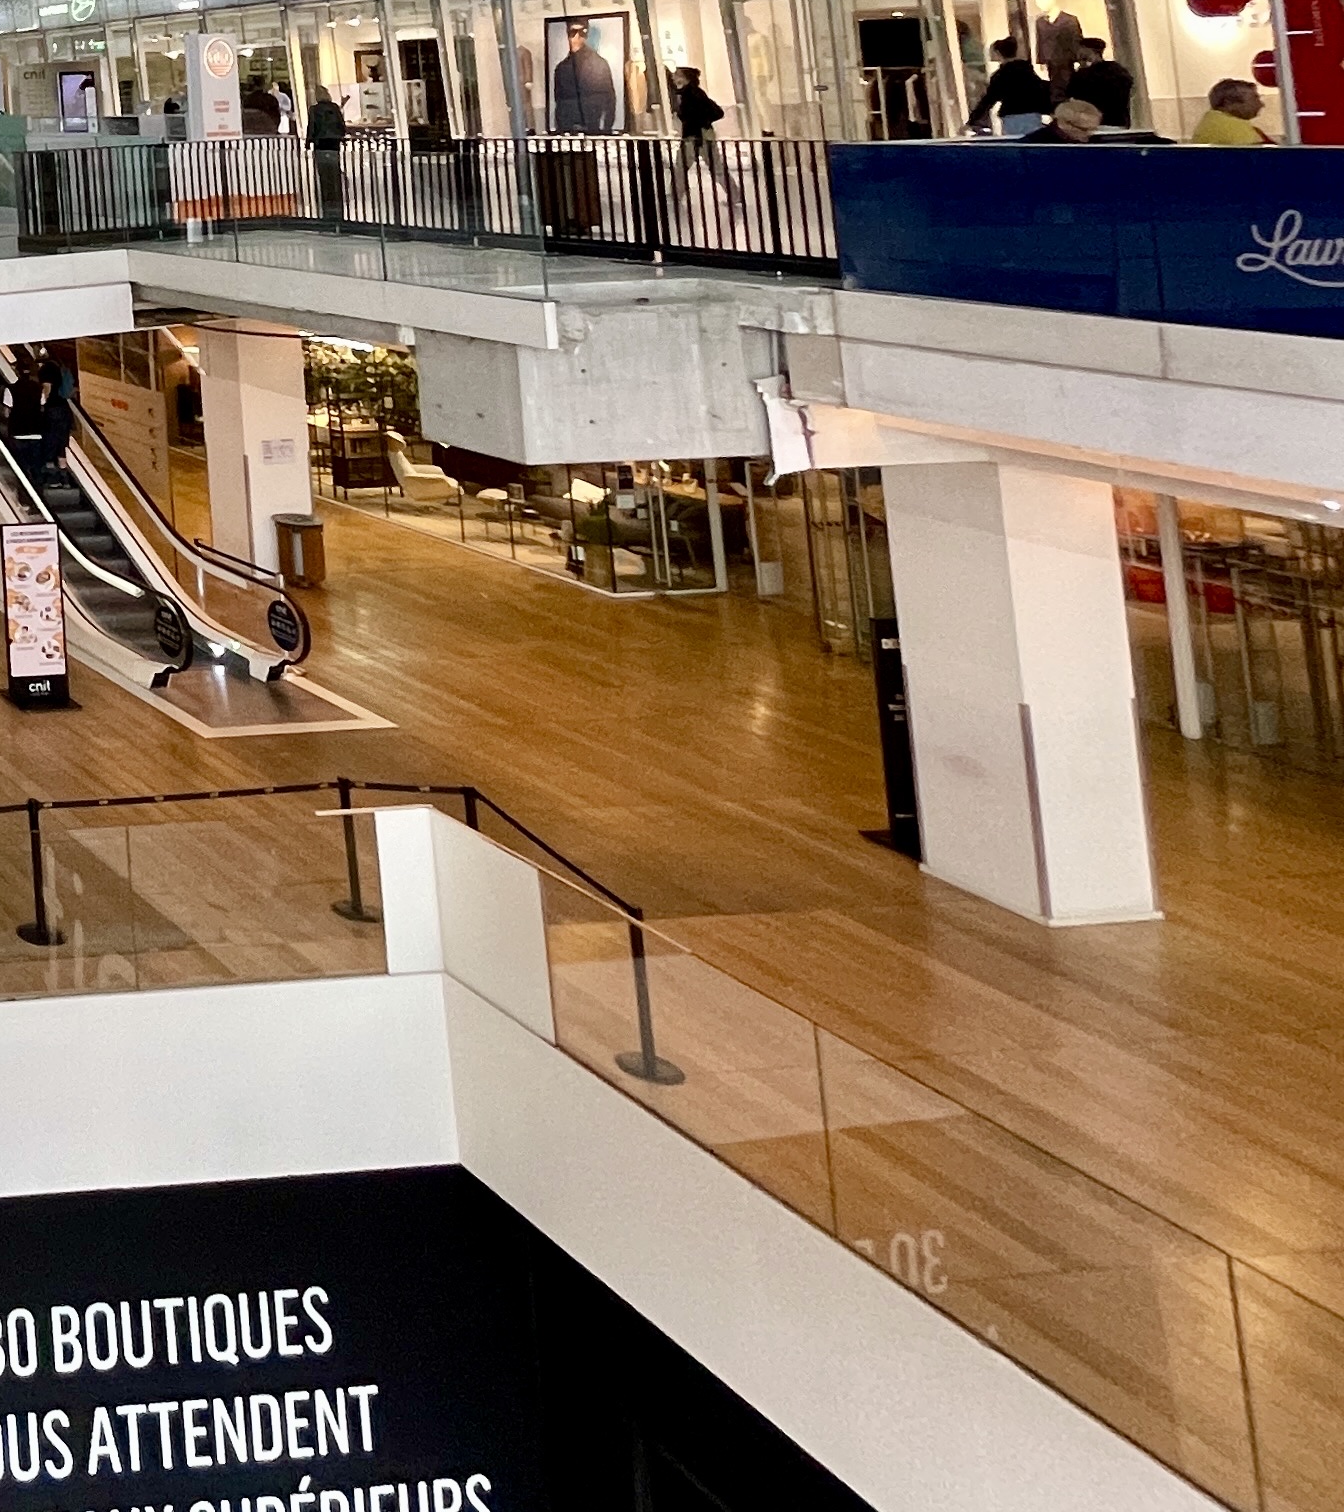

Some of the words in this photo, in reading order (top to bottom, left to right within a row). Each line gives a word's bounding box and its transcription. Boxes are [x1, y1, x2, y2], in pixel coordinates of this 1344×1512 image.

[23, 67, 46, 80] cnit
[28, 679, 51, 693] cnit
[52, 1286, 334, 1374] BOUTIQUES
[87, 1385, 379, 1477] ATTENDENT
